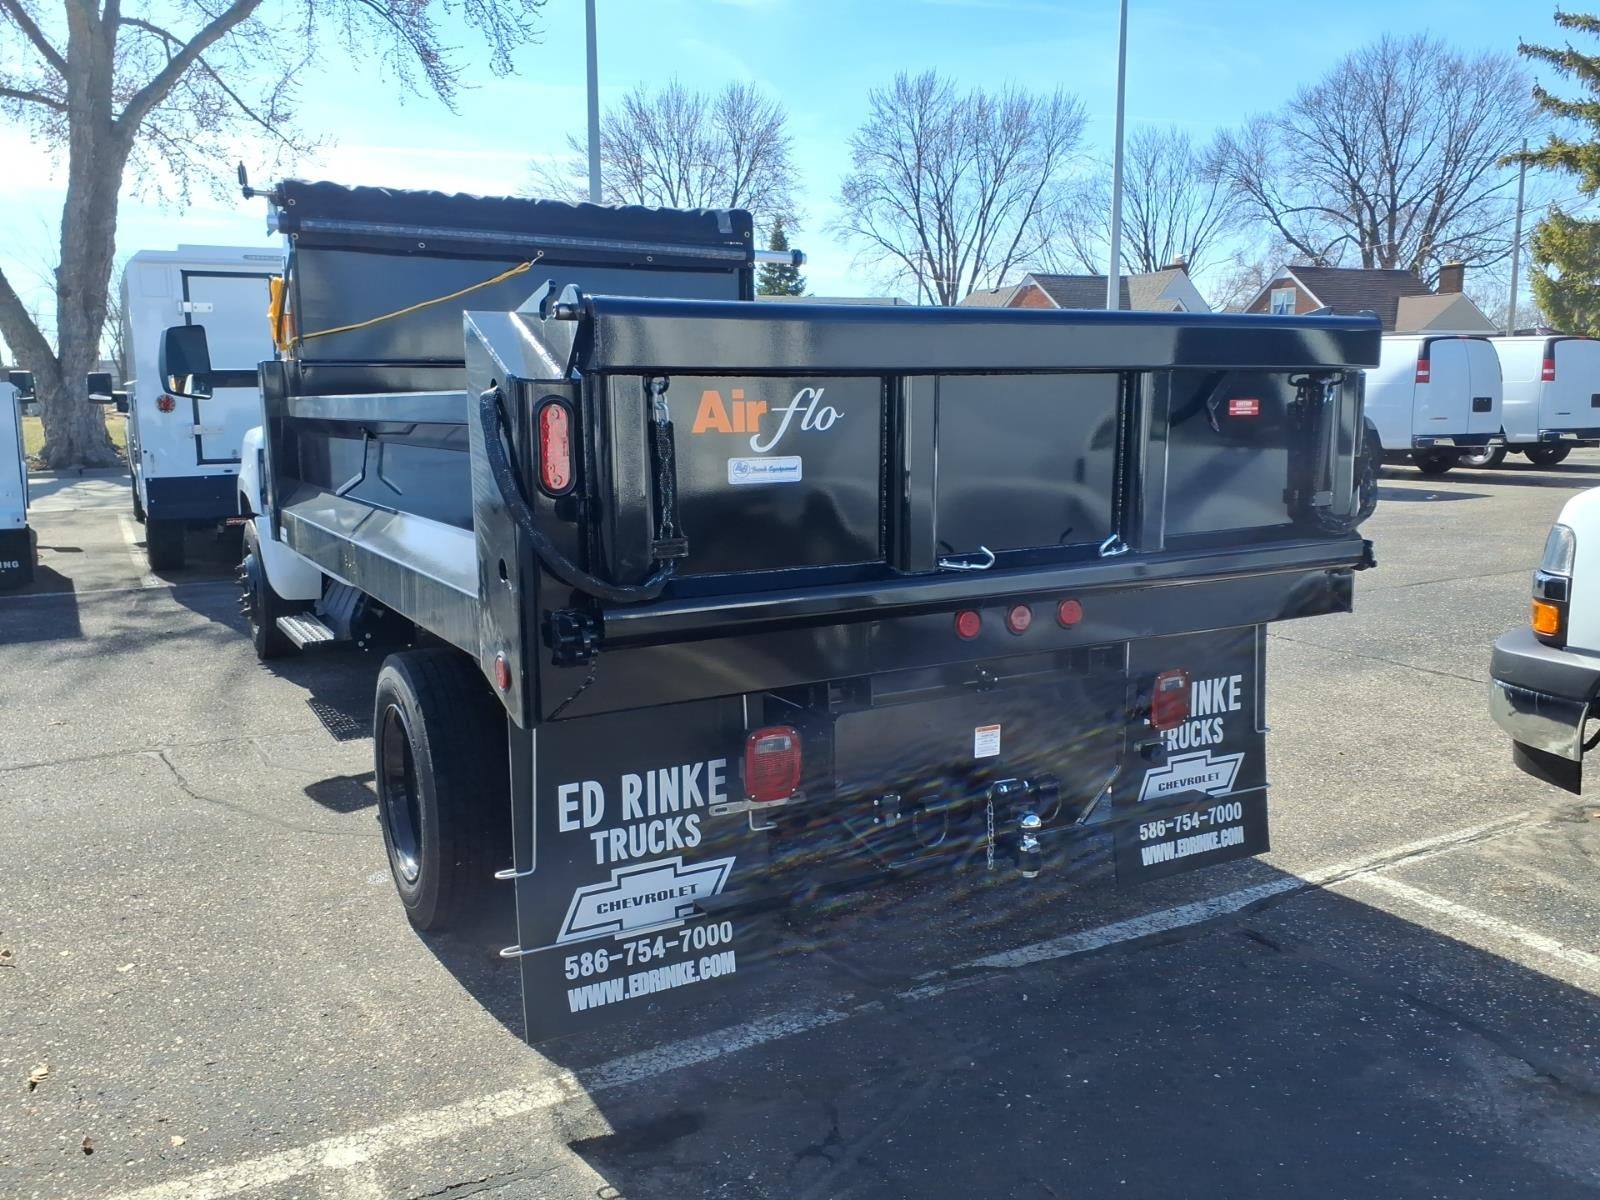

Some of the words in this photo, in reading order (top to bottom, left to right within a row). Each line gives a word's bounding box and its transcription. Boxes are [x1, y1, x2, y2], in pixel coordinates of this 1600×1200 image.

[692, 388, 768, 433] Air
[750, 387, 845, 453] flo
[1190, 674, 1242, 717] INKE
[558, 780, 605, 833] ED
[621, 758, 727, 821] RINKE
[1158, 772, 1220, 792] CHEVROLET
[590, 813, 701, 865] TRUCKS
[1140, 802, 1242, 841] 586-754-7000
[1141, 826, 1244, 867] WWW.EDRINKE.COM
[596, 883, 698, 915] CHEVROLET
[565, 920, 733, 980] 586-754-7000
[567, 950, 736, 1013] WWW.EDRINKE.COM
